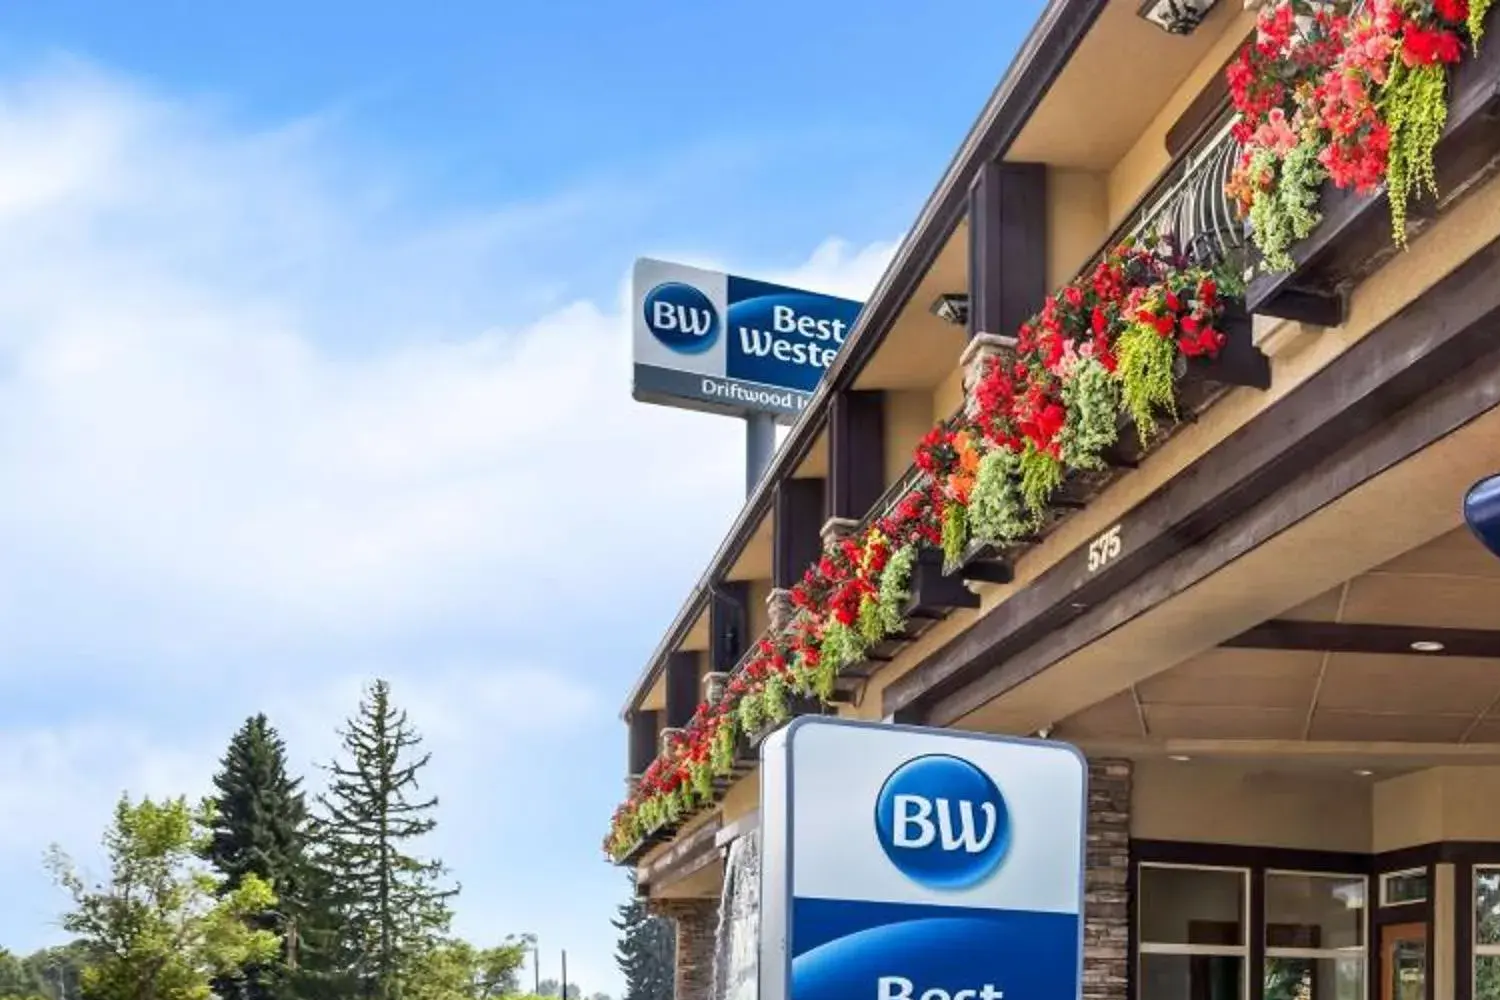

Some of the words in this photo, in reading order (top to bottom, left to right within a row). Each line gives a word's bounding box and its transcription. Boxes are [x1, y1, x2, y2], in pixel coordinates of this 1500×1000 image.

[653, 302, 710, 336] BW
[773, 305, 845, 343] Best
[739, 327, 836, 368] Weste
[702, 379, 791, 408] Driftwood
[1088, 525, 1121, 571] 575
[893, 795, 996, 853] BW
